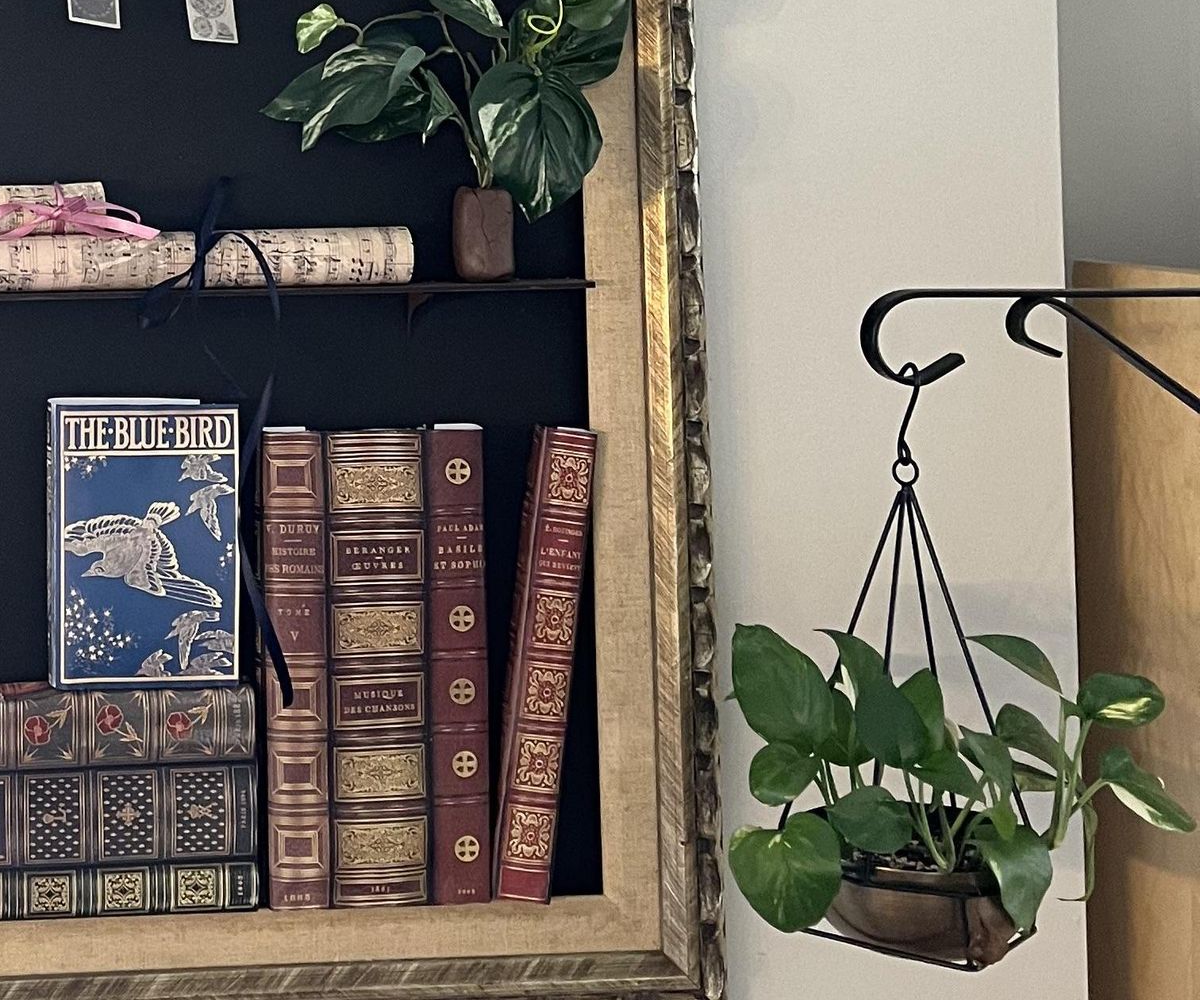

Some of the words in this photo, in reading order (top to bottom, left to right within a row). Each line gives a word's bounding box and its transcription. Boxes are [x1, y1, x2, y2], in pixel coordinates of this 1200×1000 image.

[65, 416, 110, 450] THE
[113, 416, 170, 450] BLUE
[174, 415, 232, 449] BIRD
[279, 524, 320, 534] DURUY
[437, 523, 460, 532] PAUL
[271, 547, 316, 556] HISTOIRE
[433, 562, 447, 570] ET
[290, 631, 300, 642] V
[354, 689, 404, 700] MUSIQUE
[343, 705, 362, 714] DES
[364, 703, 416, 713] CHANSONS
